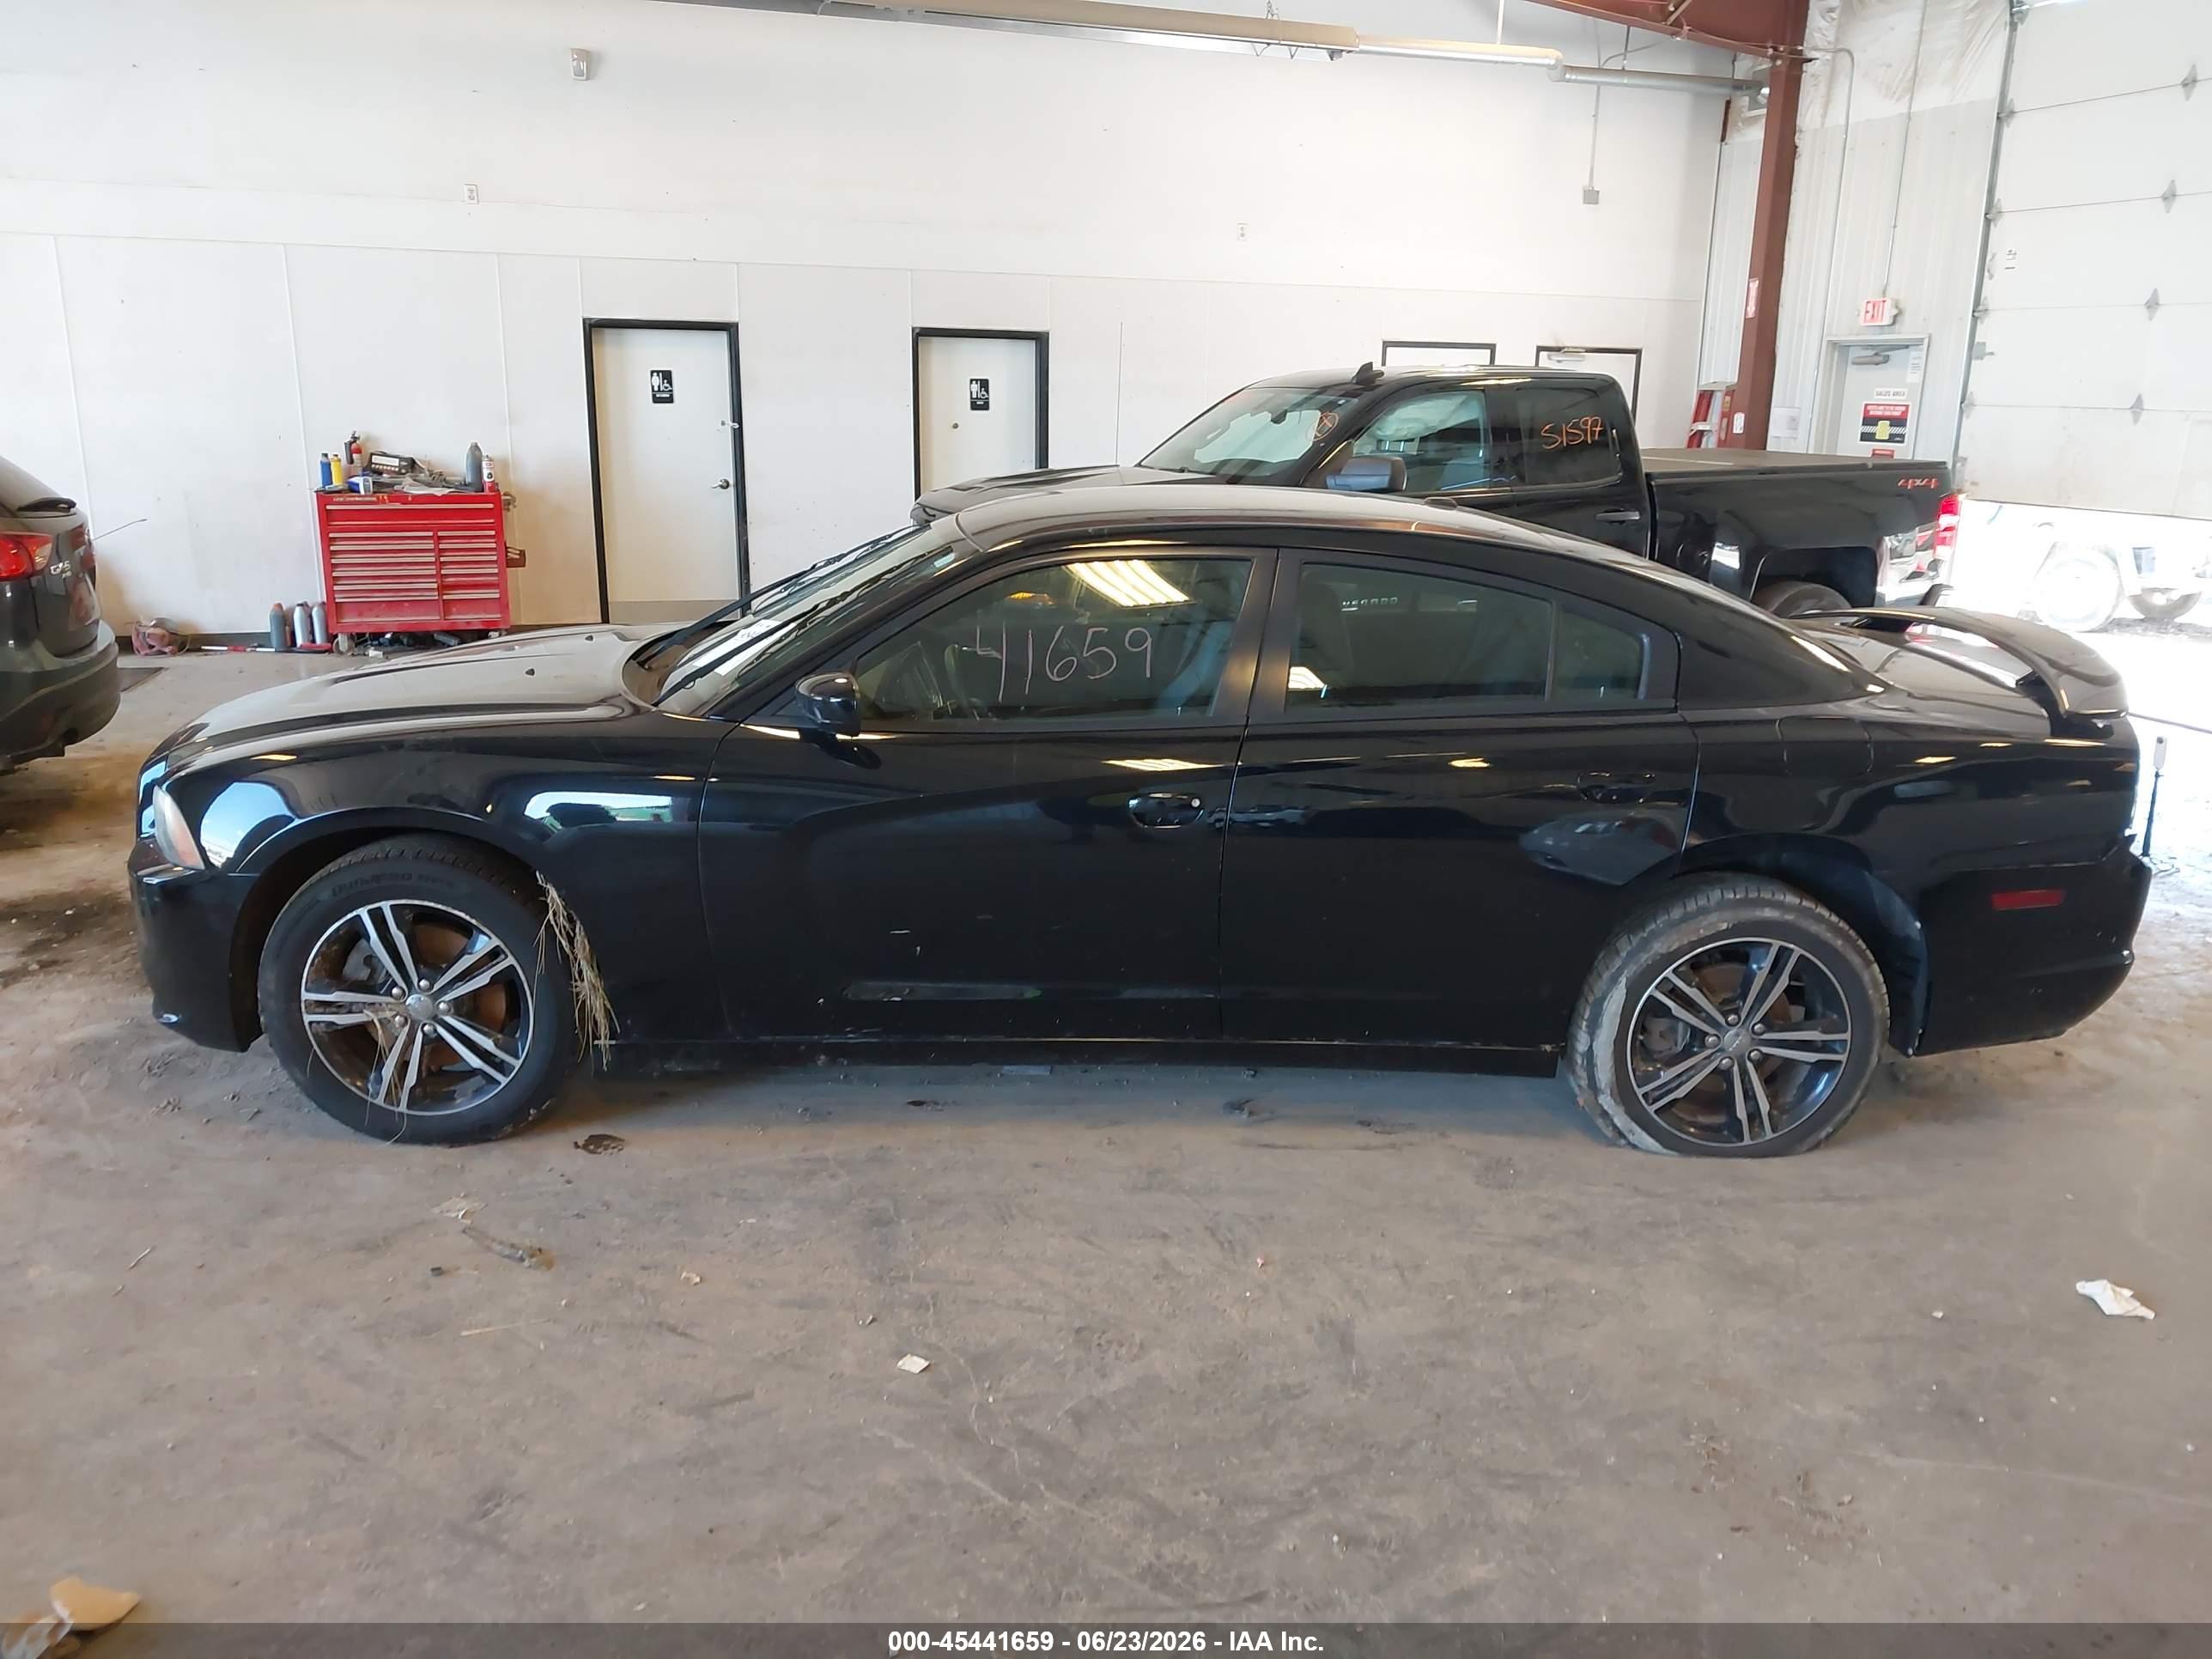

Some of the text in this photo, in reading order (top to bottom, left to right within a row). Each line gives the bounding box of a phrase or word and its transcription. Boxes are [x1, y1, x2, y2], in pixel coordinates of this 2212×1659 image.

[1863, 299, 1887, 324] EXIT
[1540, 416, 1604, 450] 51597
[975, 622, 1152, 702] 41659
